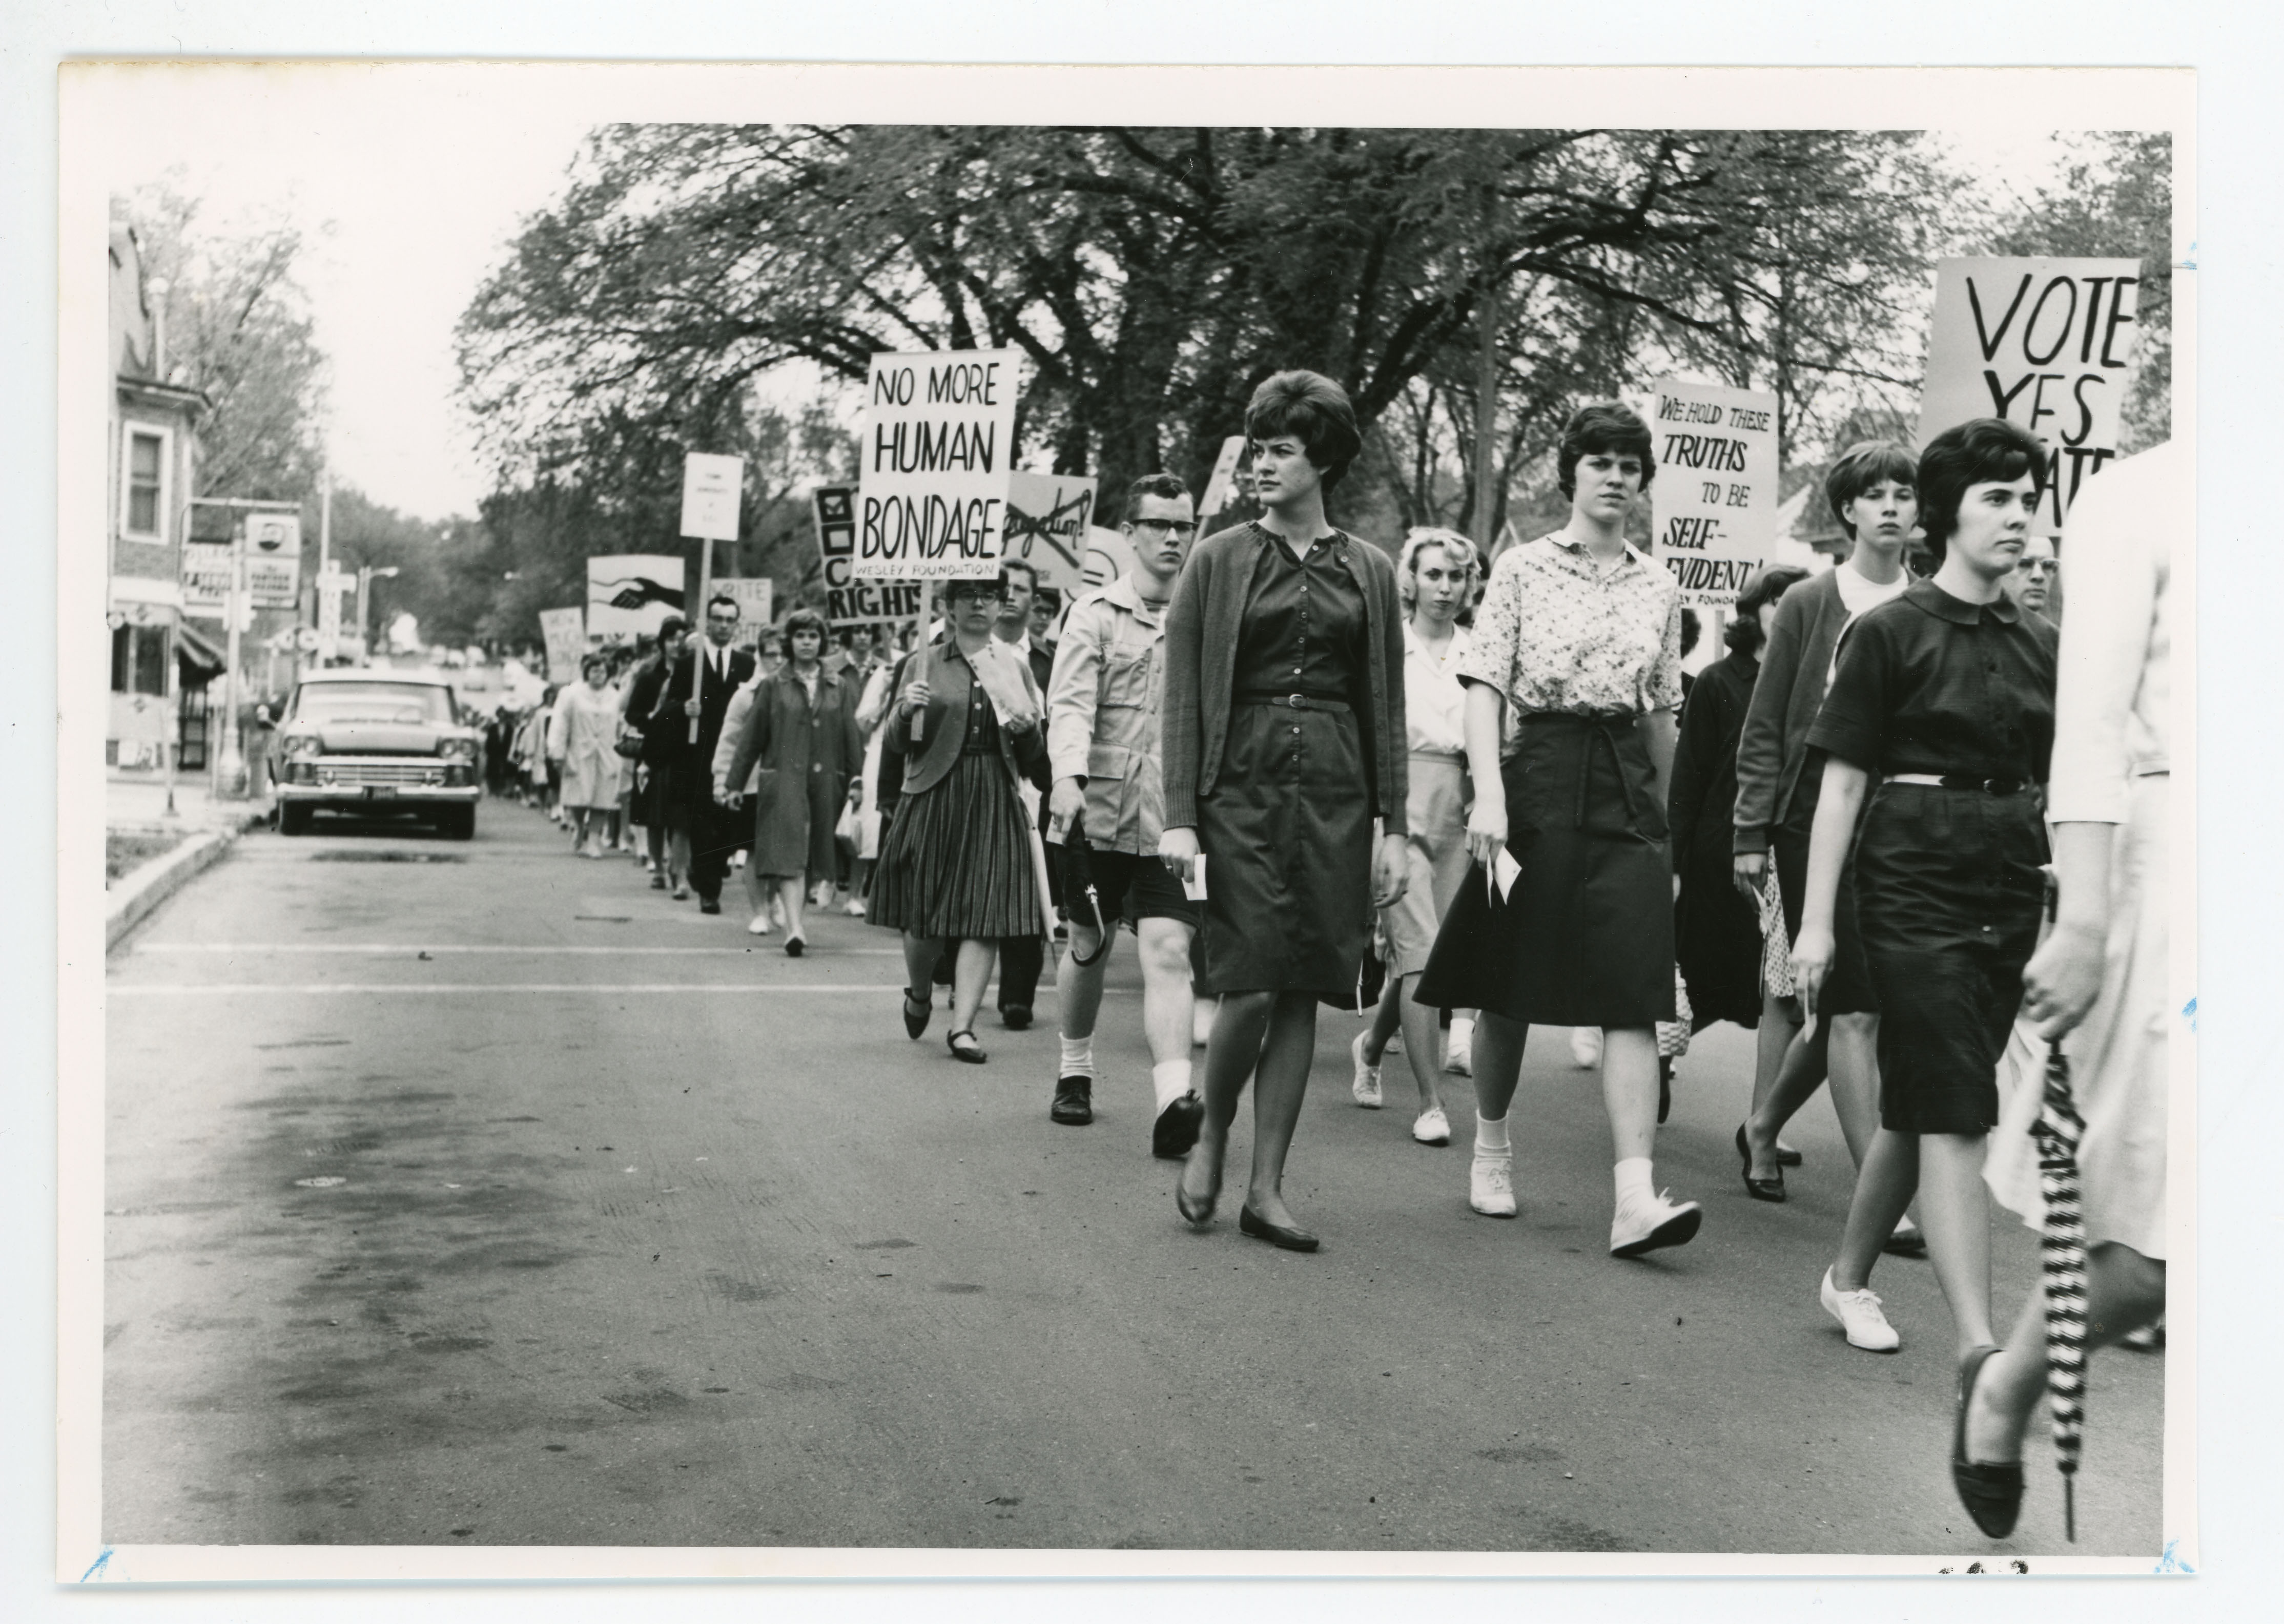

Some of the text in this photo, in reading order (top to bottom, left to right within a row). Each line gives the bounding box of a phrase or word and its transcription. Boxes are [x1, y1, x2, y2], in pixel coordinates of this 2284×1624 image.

[1966, 274, 2139, 368] VOTE
[874, 362, 1000, 406] NO MORE
[1659, 395, 1771, 431] WE HOLD THESE
[1983, 370, 2106, 446] YES
[874, 421, 994, 473] HUMAN
[1662, 434, 1748, 472] TRUTHS
[1702, 482, 1751, 507] TO BE
[862, 494, 1001, 559] BONDAGE
[1662, 516, 1727, 550] SELF-
[856, 564, 995, 576] WESLEY FOUNDATION
